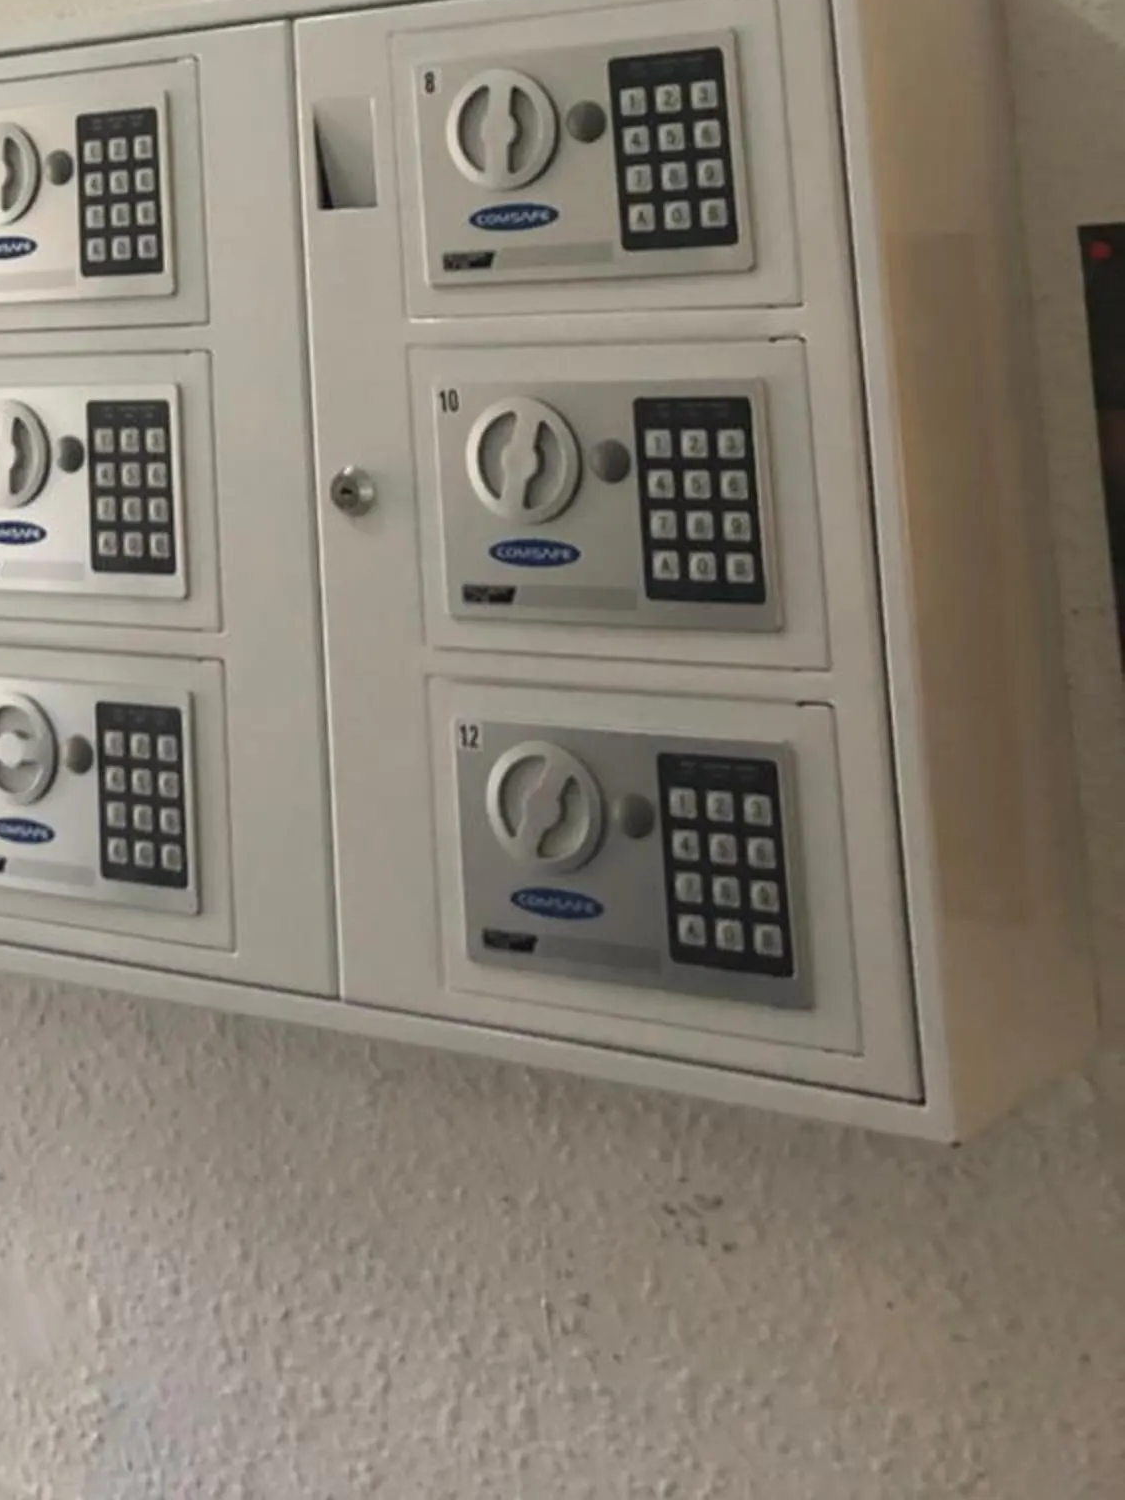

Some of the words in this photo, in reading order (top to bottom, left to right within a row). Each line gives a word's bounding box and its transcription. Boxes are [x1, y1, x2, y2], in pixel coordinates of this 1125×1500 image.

[423, 71, 436, 94] 8
[476, 208, 550, 226] COMSAFE
[439, 388, 459, 412] 10
[496, 545, 573, 562] COMSAFE
[459, 724, 479, 749] 12
